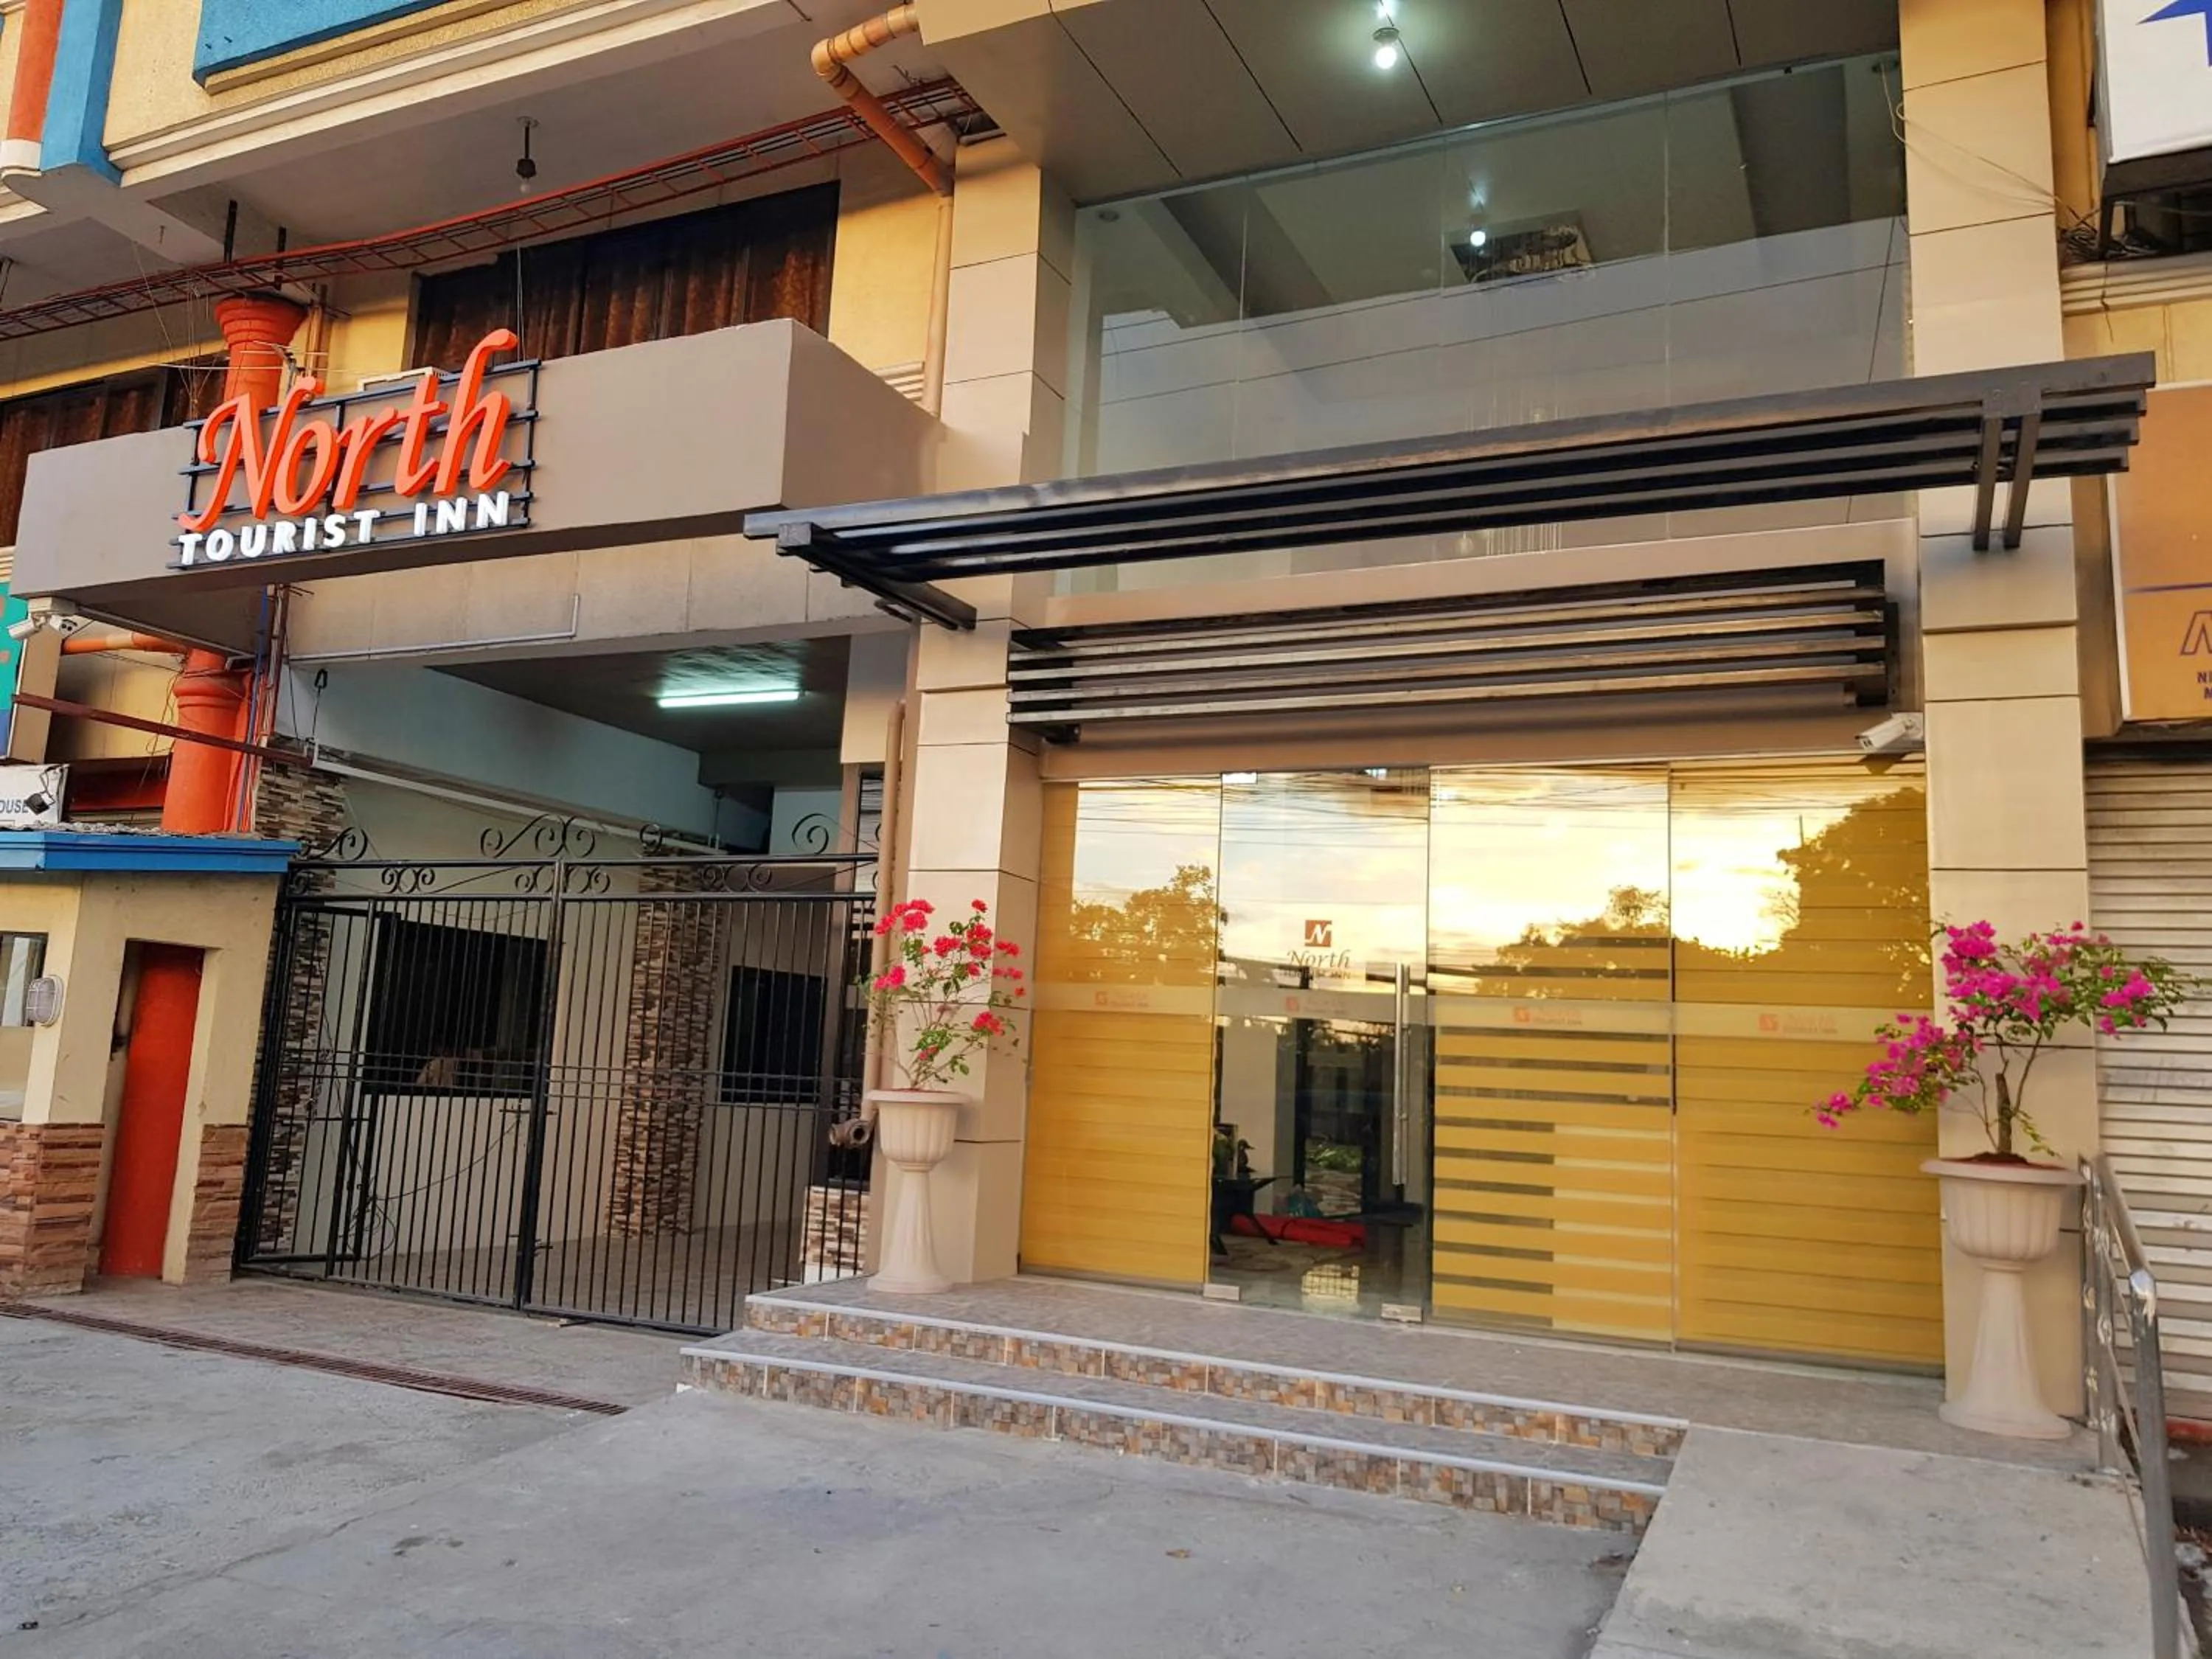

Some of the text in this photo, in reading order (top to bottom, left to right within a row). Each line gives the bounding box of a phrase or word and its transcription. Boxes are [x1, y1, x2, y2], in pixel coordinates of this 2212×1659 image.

[179, 329, 518, 532] North
[178, 491, 510, 566] TOURIST INN
[1287, 949, 1351, 970] North
